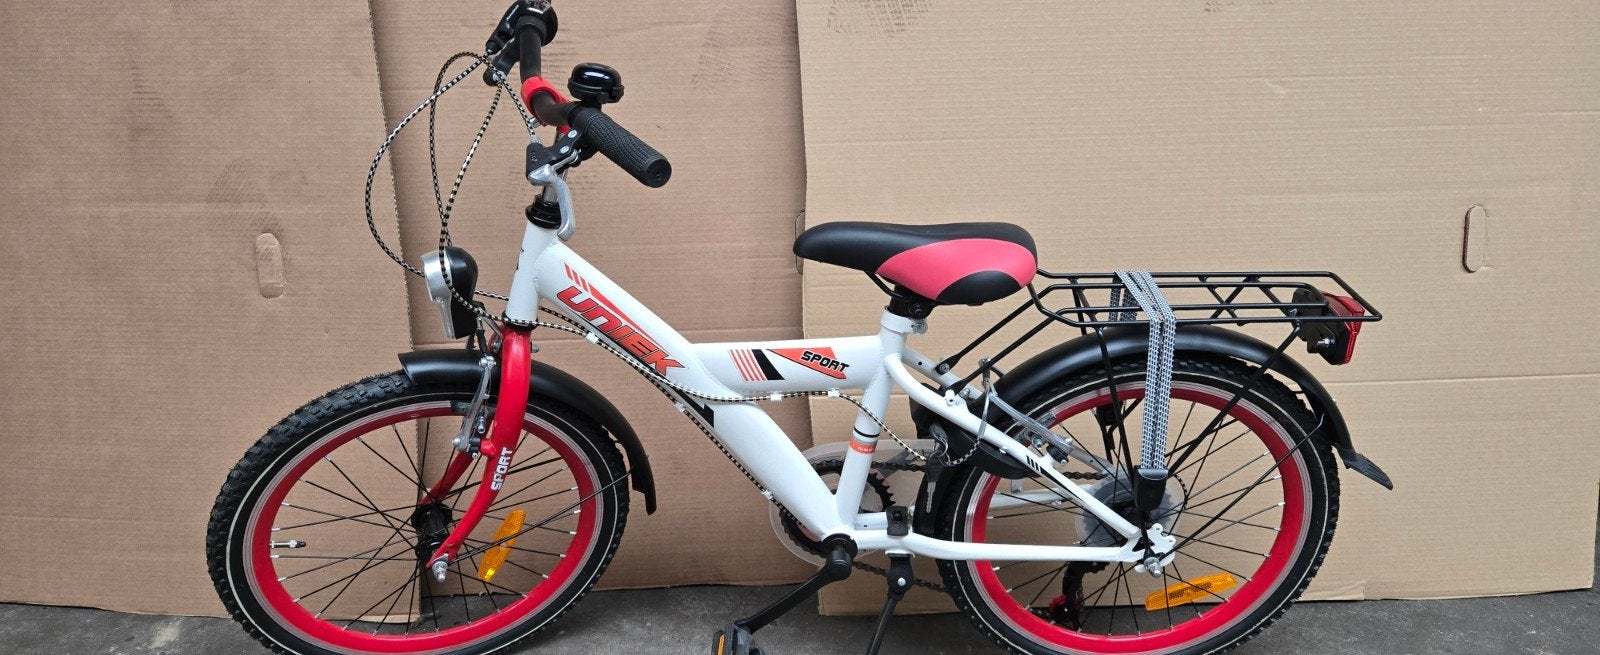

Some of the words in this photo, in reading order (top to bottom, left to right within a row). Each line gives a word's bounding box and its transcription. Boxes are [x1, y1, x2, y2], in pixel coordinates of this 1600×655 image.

[557, 286, 685, 376] UNIEK
[800, 350, 850, 373] SPORT
[490, 446, 513, 491] SPORT
